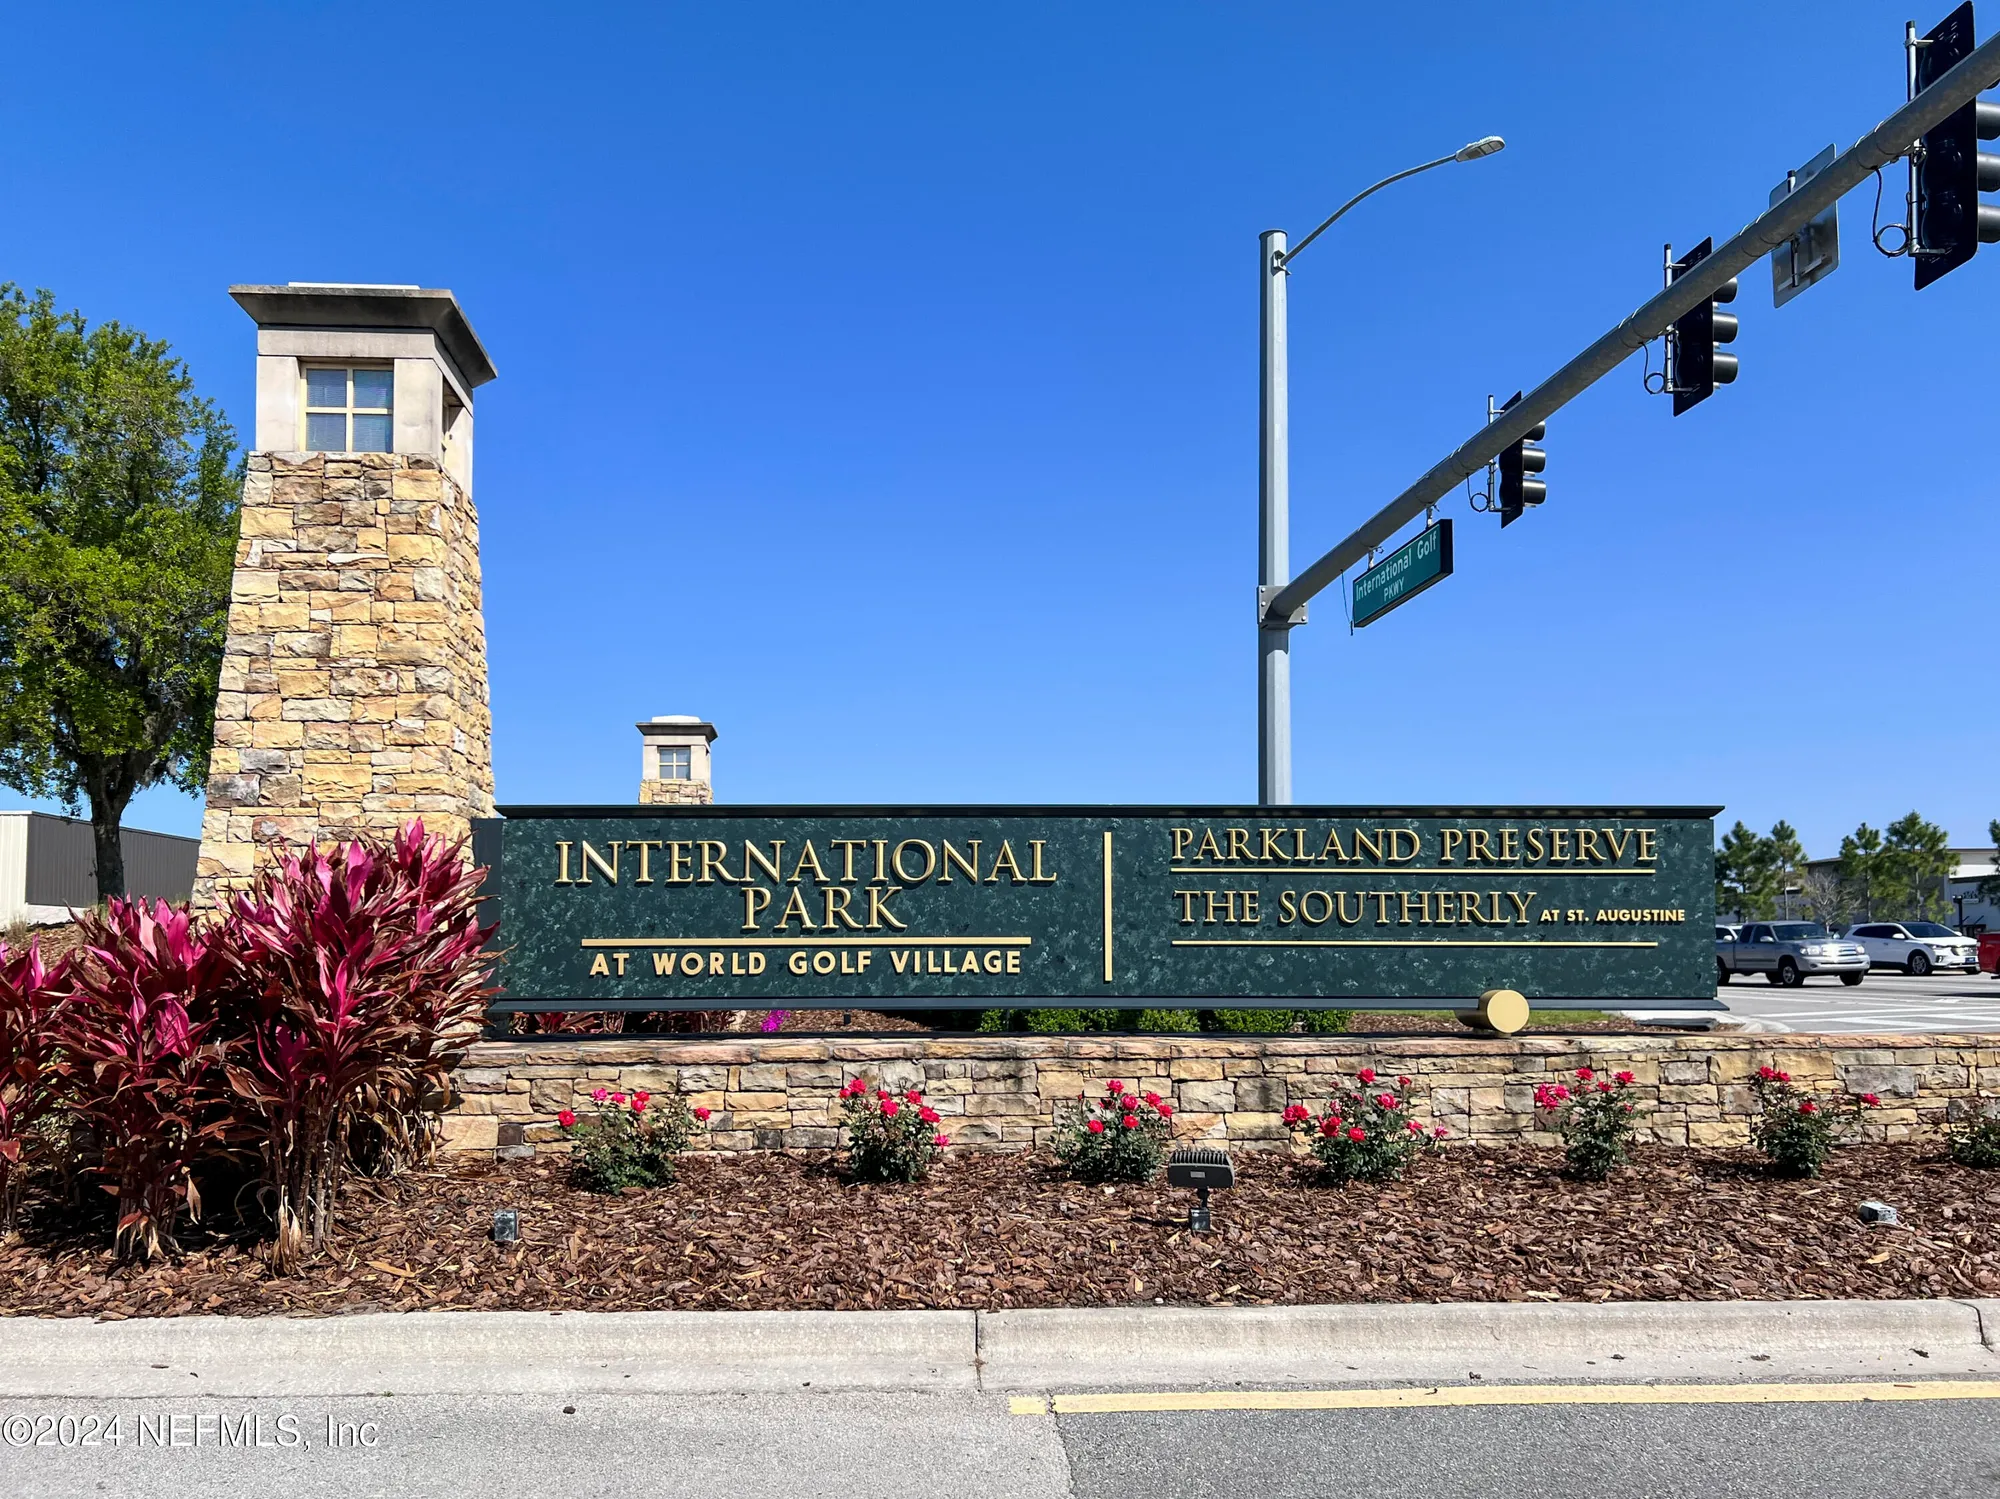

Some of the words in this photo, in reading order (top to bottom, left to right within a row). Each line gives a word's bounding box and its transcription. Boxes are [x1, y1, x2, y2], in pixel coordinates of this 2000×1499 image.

[1356, 549, 1412, 601] International
[1417, 531, 1437, 560] Golf
[1384, 577, 1405, 602] PKWY
[554, 838, 1058, 885] INTERNATIONAL
[1171, 827, 1420, 862] PARKLAND
[1440, 827, 1658, 862] PRESERVE
[741, 886, 908, 931] PARK
[1174, 890, 1261, 925] THE
[1278, 889, 1537, 926] SOUTHERLY
[1540, 909, 1560, 923] AT
[1567, 909, 1591, 923] ST.
[1596, 909, 1686, 923] AUGUSTINE
[589, 952, 630, 976] AT
[653, 951, 767, 976] WORLD
[788, 949, 872, 976] GOLF
[889, 949, 1022, 975] VILLAGE
